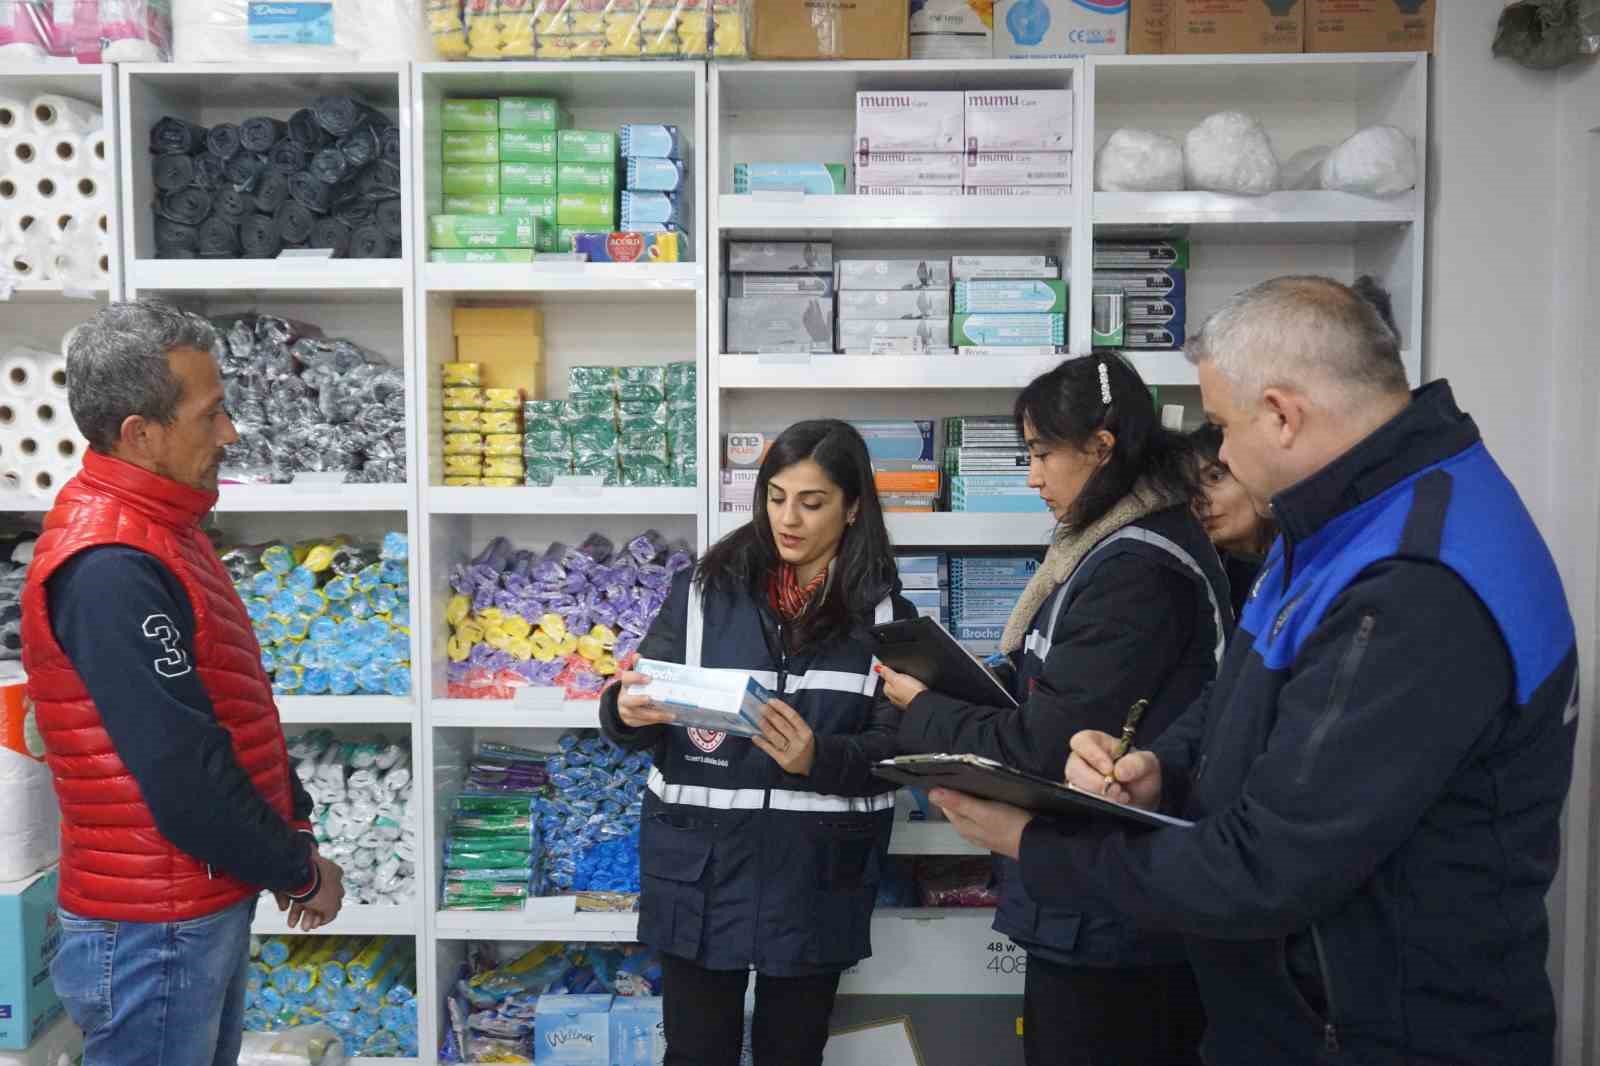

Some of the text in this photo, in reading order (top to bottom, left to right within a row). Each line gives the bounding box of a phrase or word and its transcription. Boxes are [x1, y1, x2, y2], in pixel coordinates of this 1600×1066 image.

[860, 95, 911, 107] mumu
[968, 94, 1018, 106] mumu
[731, 436, 759, 447] one
[142, 614, 192, 677] 3
[987, 942, 1003, 952] 48
